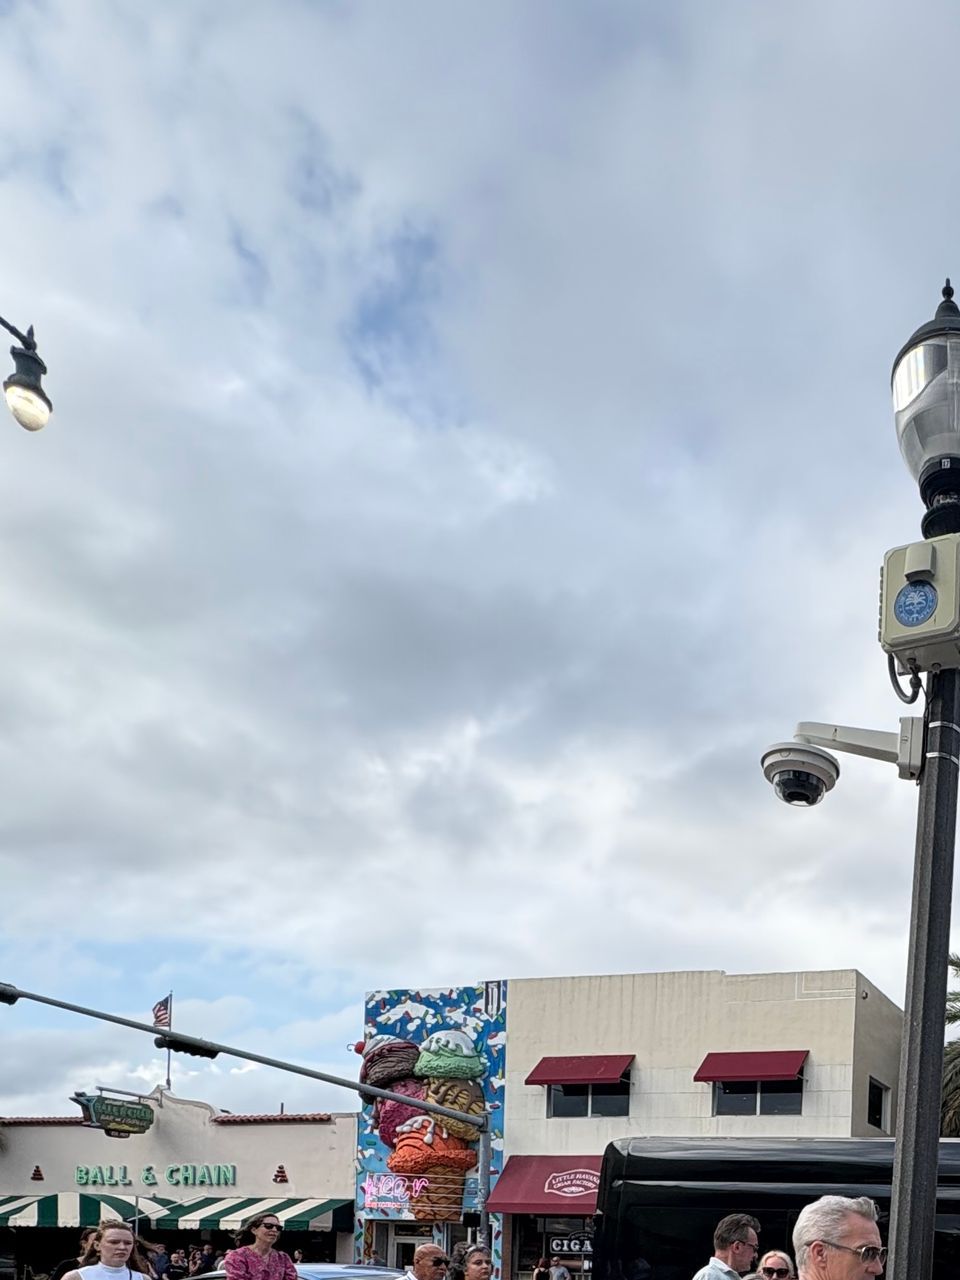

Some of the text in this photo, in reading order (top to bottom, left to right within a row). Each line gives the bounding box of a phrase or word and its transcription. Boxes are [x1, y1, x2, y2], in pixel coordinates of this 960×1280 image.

[75, 1164, 237, 1186] BALL & CHAIN
[552, 1174, 575, 1184] LITTLE
[553, 1180, 596, 1189] CIGAR FACTORY
